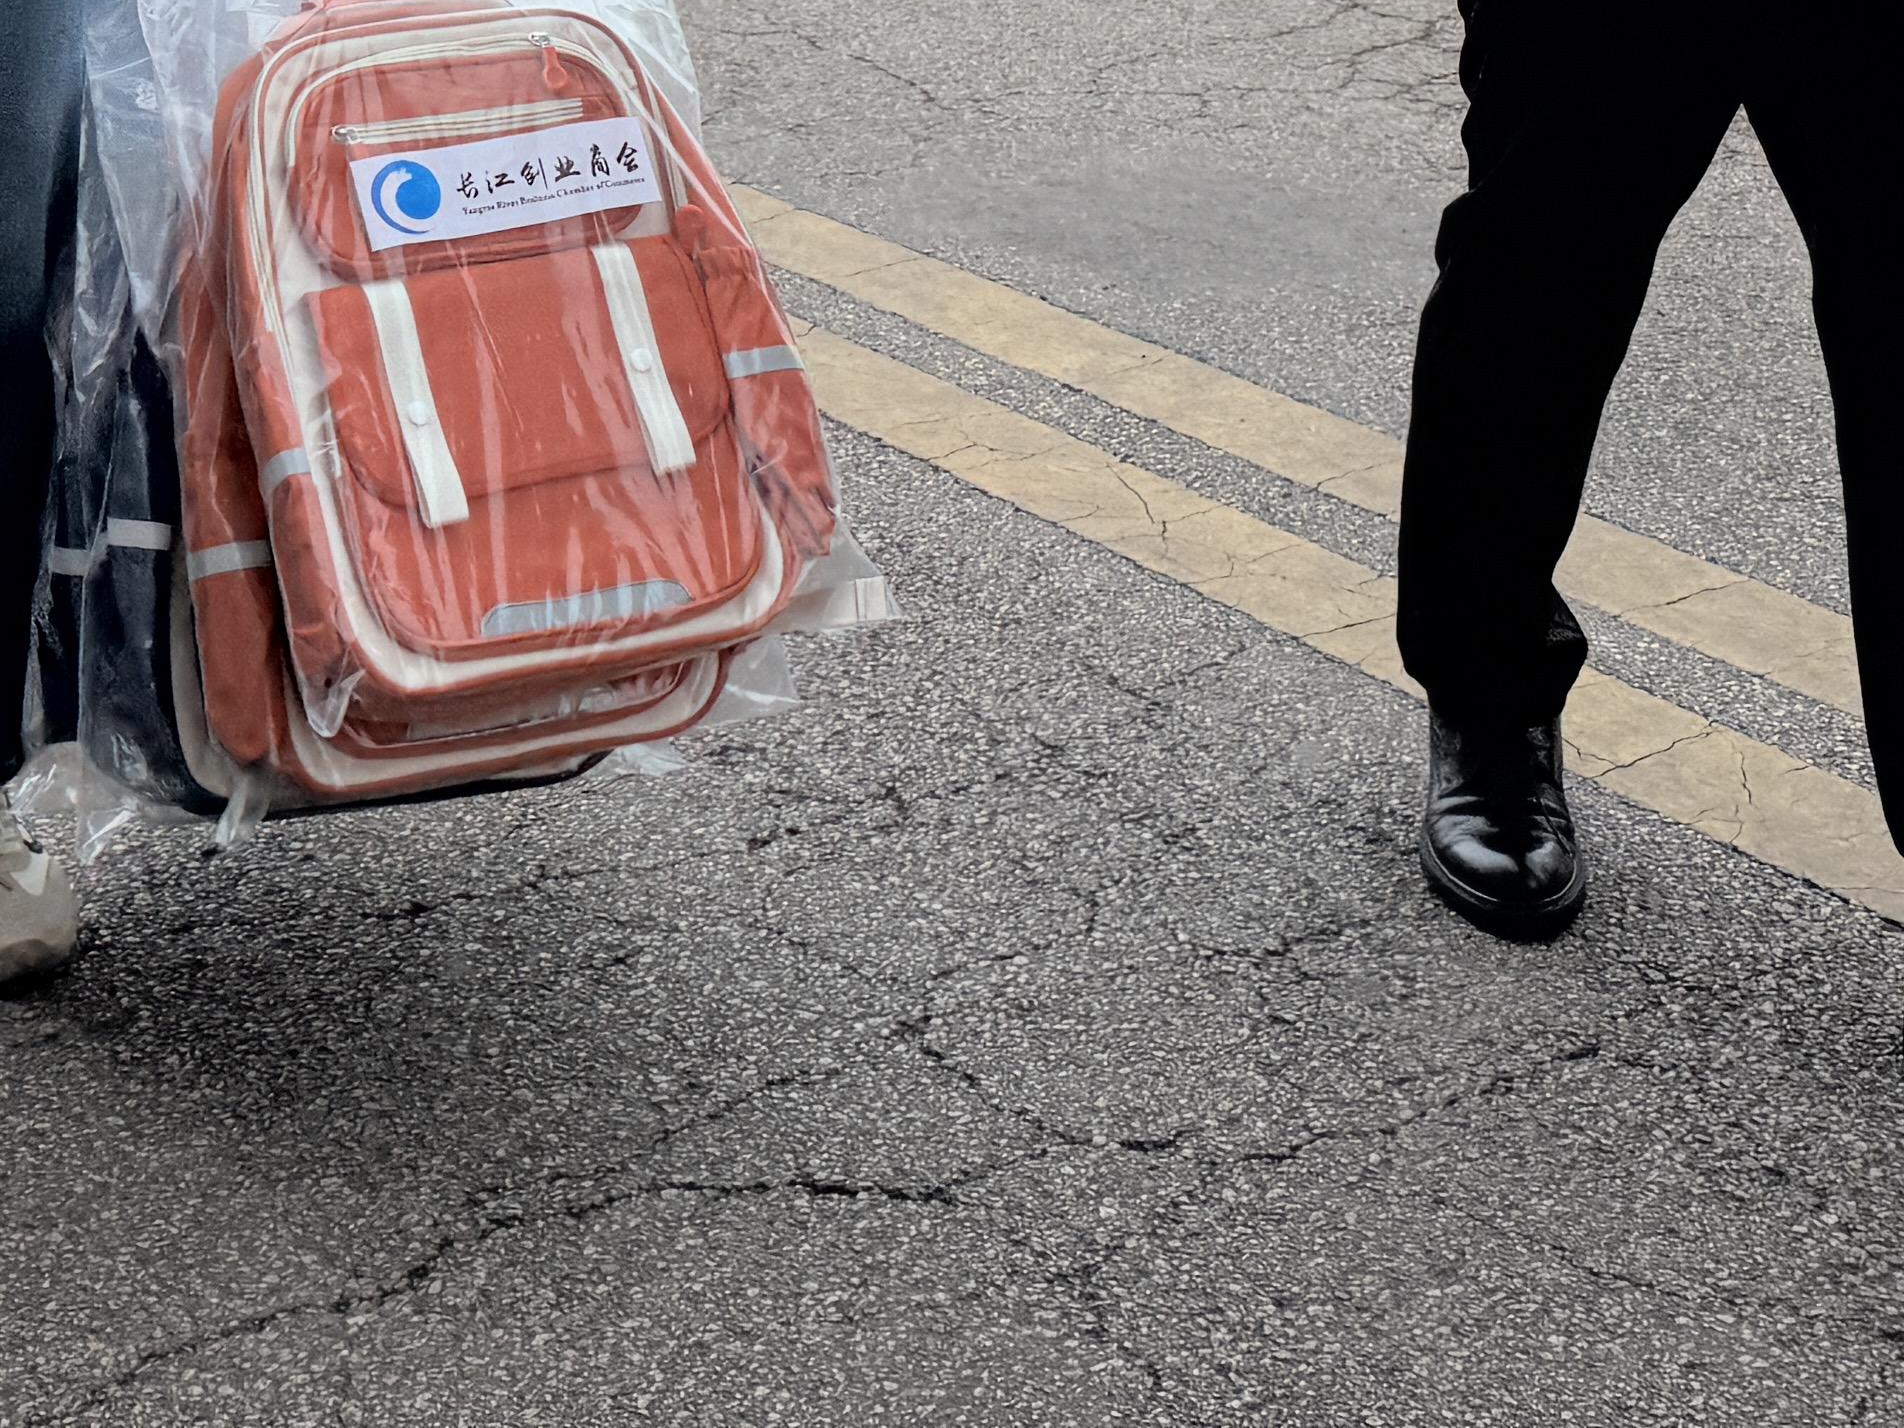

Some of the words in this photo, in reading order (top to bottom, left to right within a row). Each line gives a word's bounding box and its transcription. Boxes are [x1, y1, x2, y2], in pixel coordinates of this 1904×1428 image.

[456, 141, 640, 199] 长江创业商会
